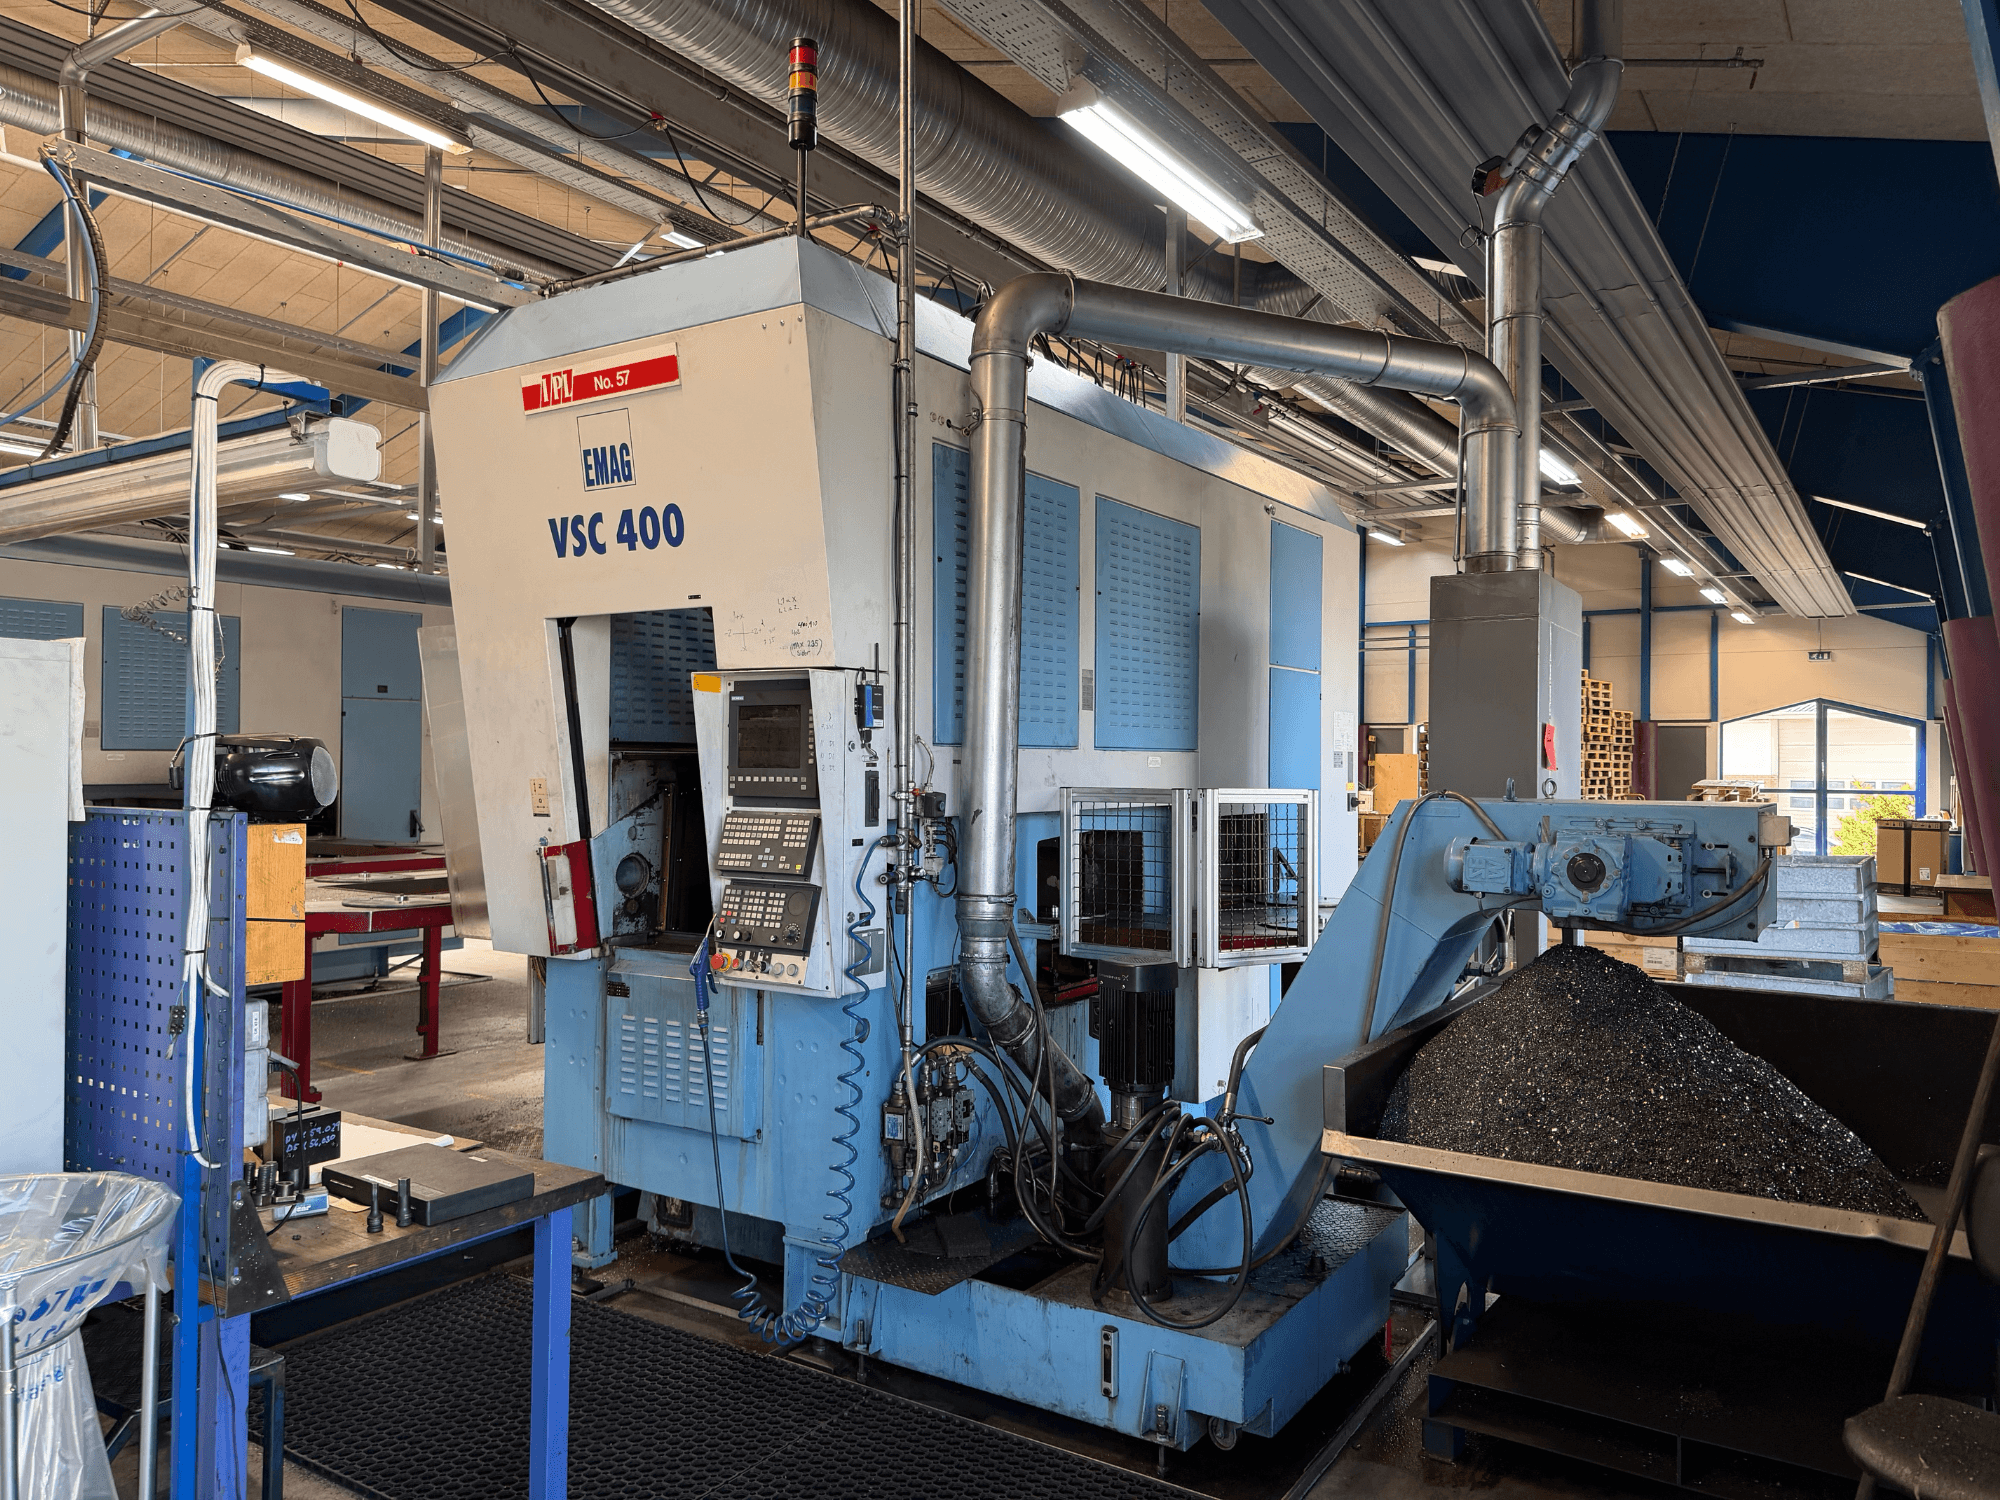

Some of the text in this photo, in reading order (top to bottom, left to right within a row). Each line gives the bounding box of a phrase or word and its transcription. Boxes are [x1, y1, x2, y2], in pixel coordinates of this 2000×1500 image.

[593, 375, 614, 391] No.
[616, 369, 630, 387] 57
[582, 442, 633, 487] EMAG
[548, 503, 685, 558] VSC 400
